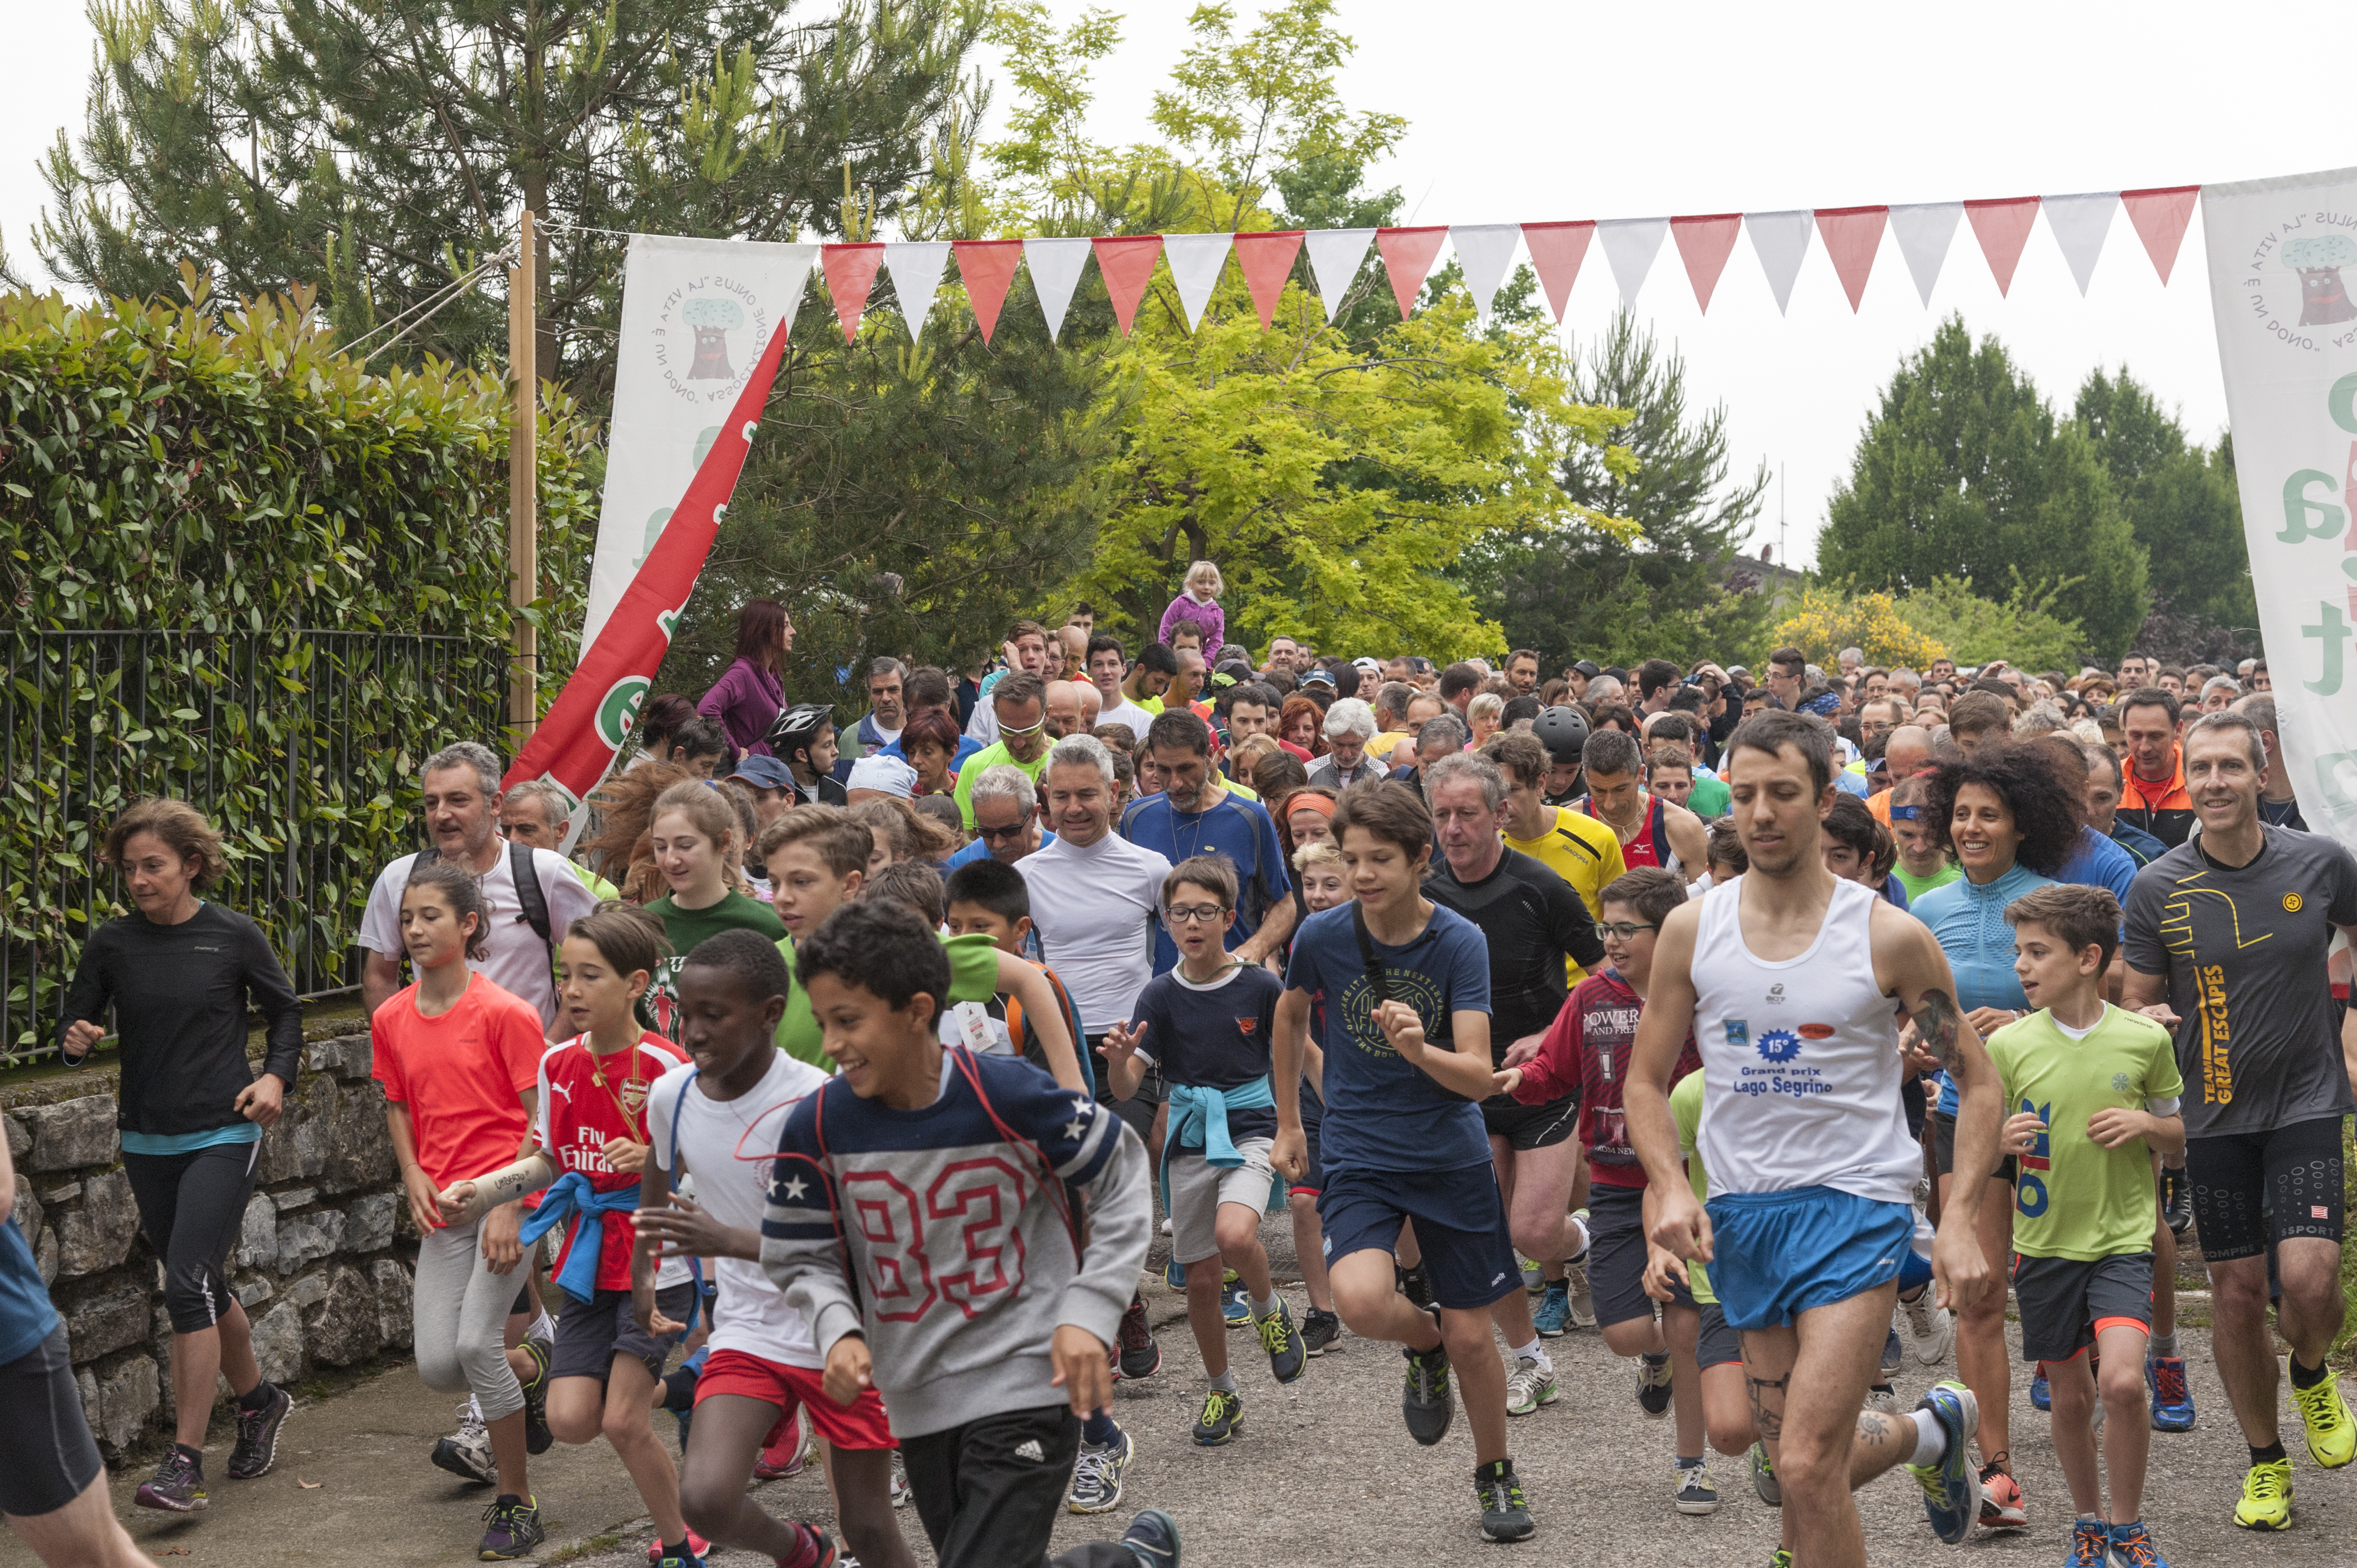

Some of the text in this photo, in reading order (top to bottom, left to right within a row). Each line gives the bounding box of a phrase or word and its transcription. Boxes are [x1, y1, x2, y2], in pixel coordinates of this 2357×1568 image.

[1562, 844, 1589, 865] DIADORA
[1403, 969, 1432, 985] NEXT
[1592, 1027, 1613, 1036] AND
[2124, 1017, 2153, 1029] newline
[2204, 964, 2233, 1104] GREAT ESCAPES
[1355, 1036, 1372, 1053] THE
[1768, 1039, 1789, 1053] 15°
[1742, 1067, 1821, 1076] Grand prix
[1734, 1076, 1833, 1097] Lago Segrino
[2203, 1059, 2215, 1105] TEAM
[578, 1126, 605, 1148] Fly
[842, 1157, 1027, 1323] 83
